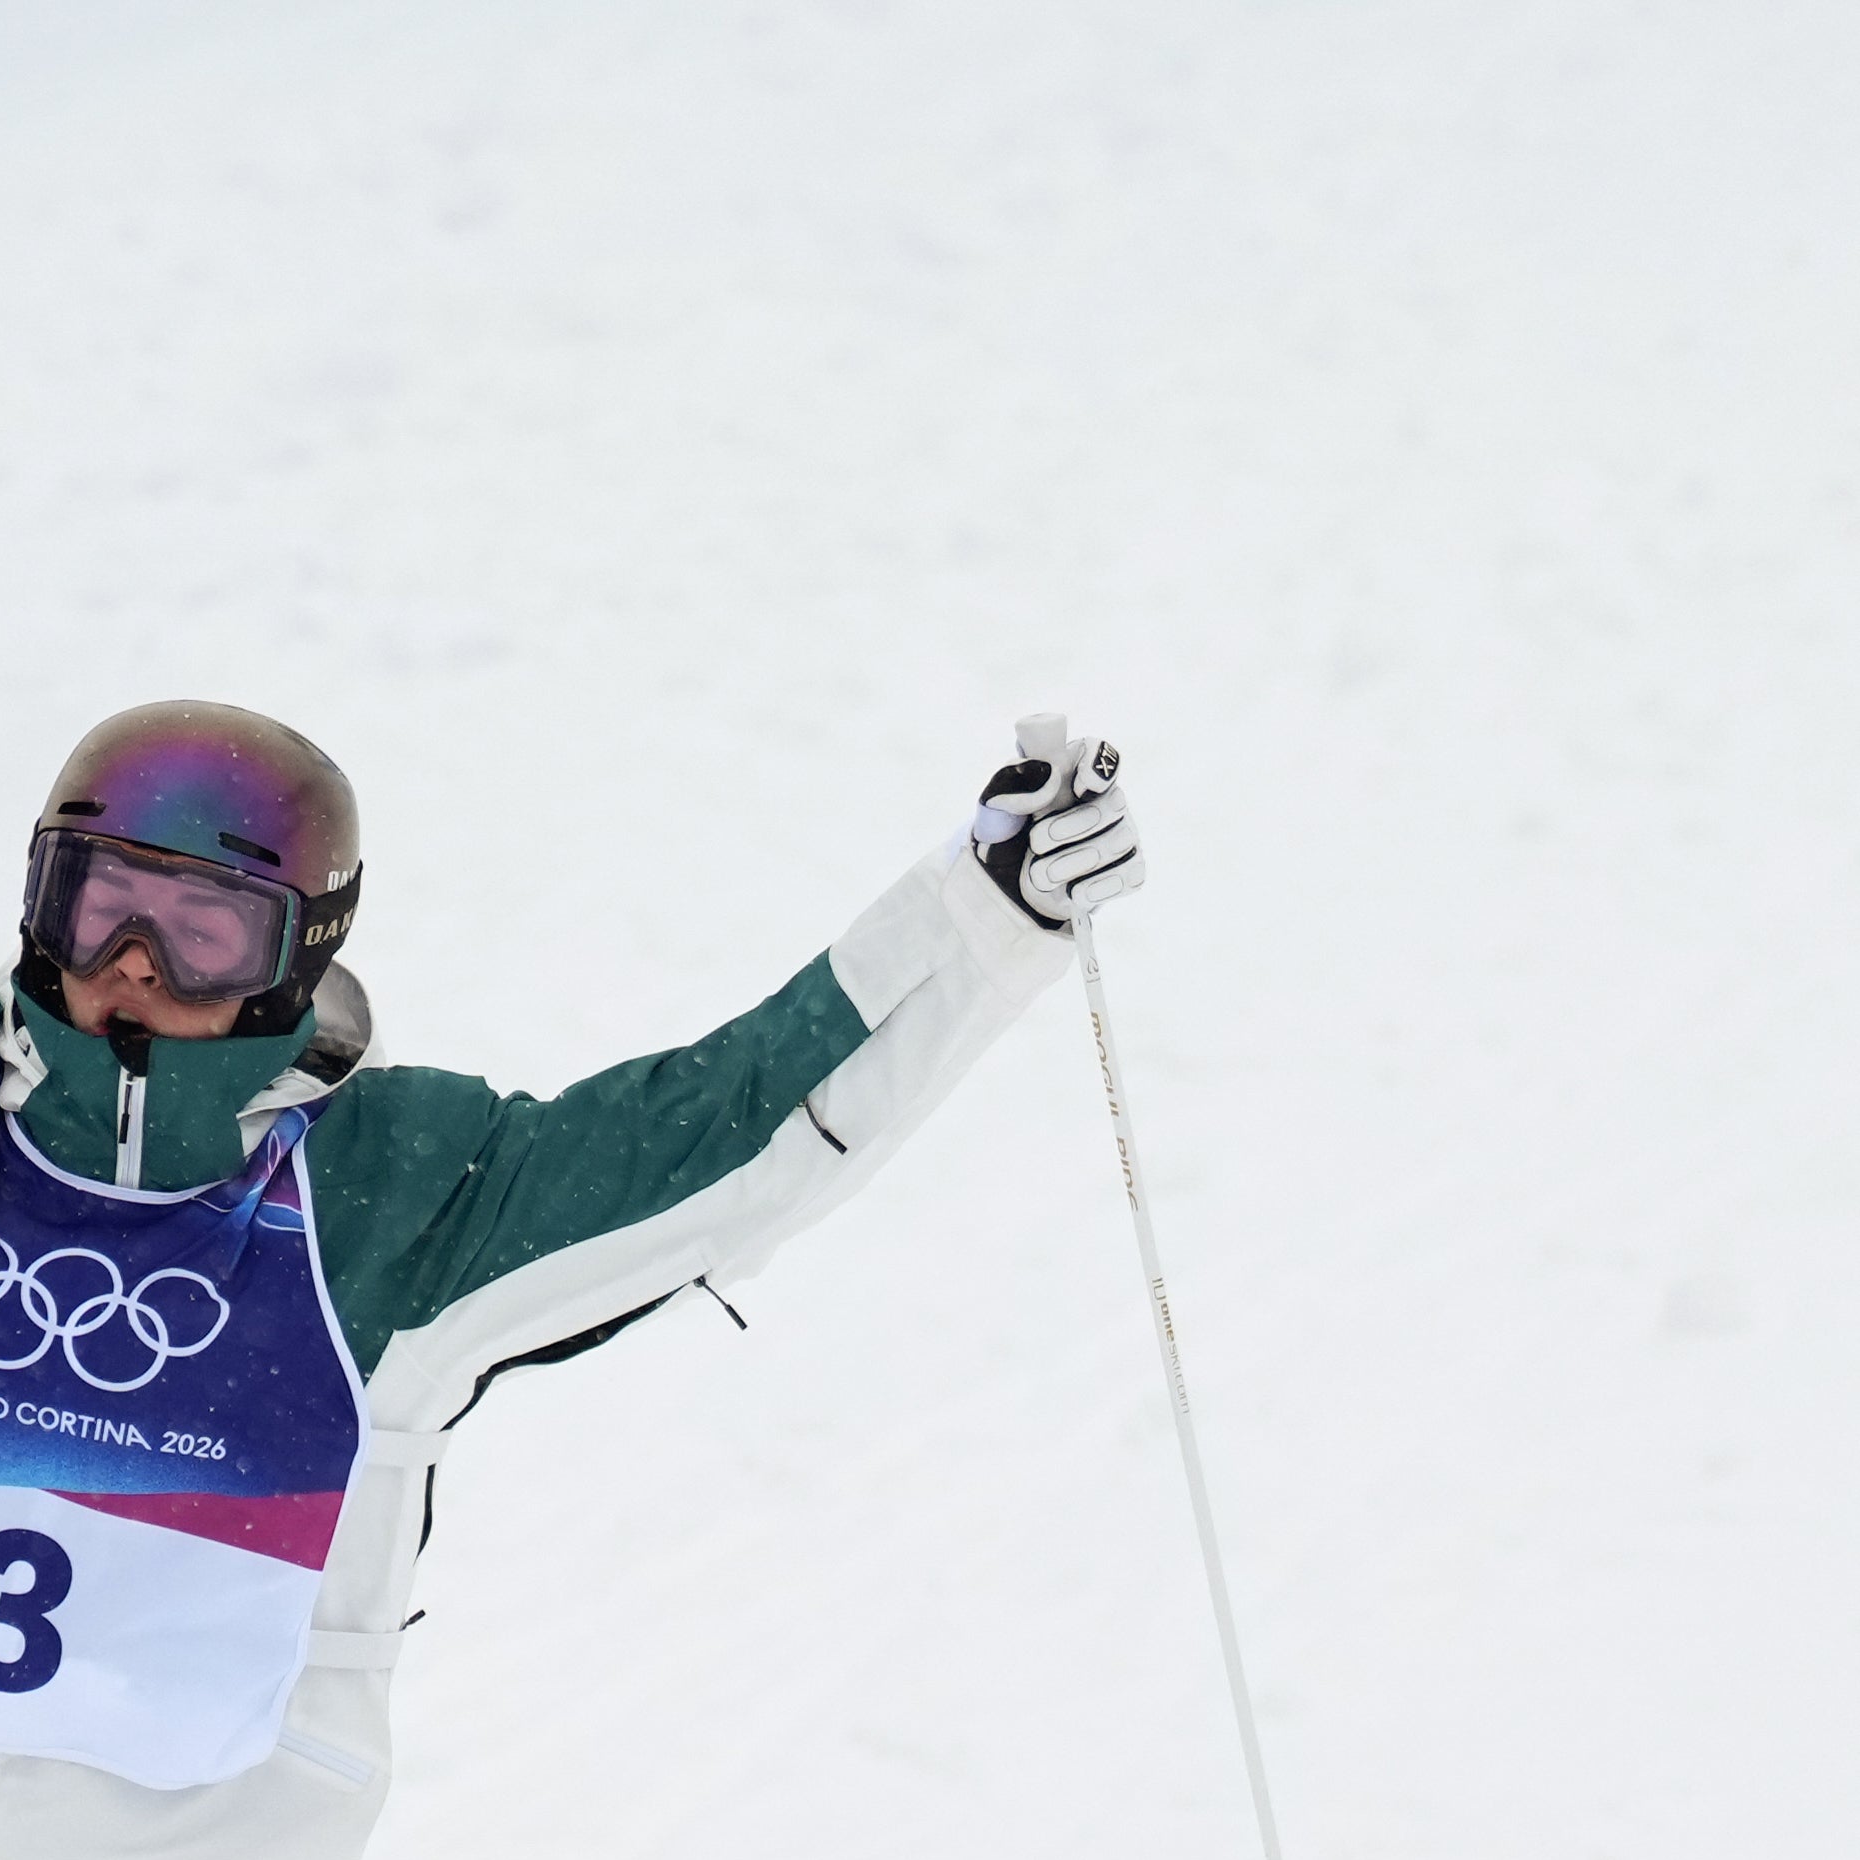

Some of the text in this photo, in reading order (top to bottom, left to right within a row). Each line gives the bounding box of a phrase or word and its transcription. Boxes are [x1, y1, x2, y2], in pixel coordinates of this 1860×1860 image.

[326, 868, 358, 892] OA
[15, 1402, 152, 1451] CORTINA
[160, 1430, 226, 1460] 2026
